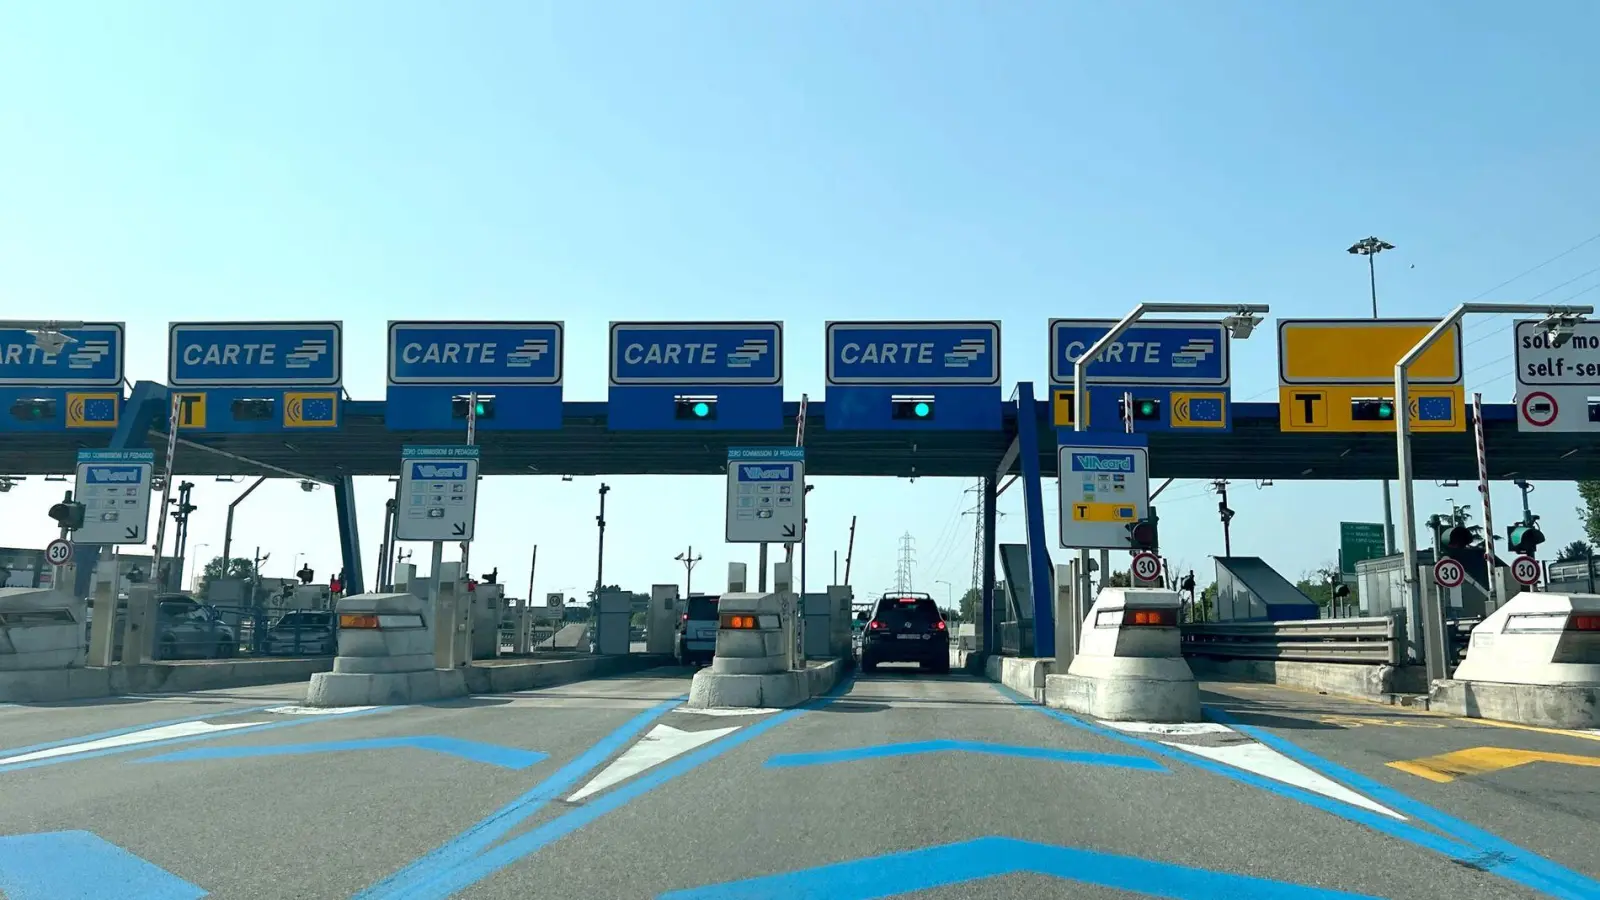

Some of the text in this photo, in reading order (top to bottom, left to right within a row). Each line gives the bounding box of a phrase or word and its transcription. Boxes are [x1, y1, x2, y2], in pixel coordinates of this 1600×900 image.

[183, 343, 276, 365] CARTE
[402, 342, 497, 364] CARTE
[624, 343, 718, 364] CARTE
[840, 342, 934, 364] CARTE
[180, 396, 201, 424] T
[1295, 394, 1322, 423] T
[1077, 455, 1131, 470] VIAcard
[1077, 506, 1088, 518] T
[51, 546, 67, 559] 30
[1139, 560, 1156, 574] 30
[1442, 567, 1459, 580] 30
[1518, 564, 1535, 577] 30
